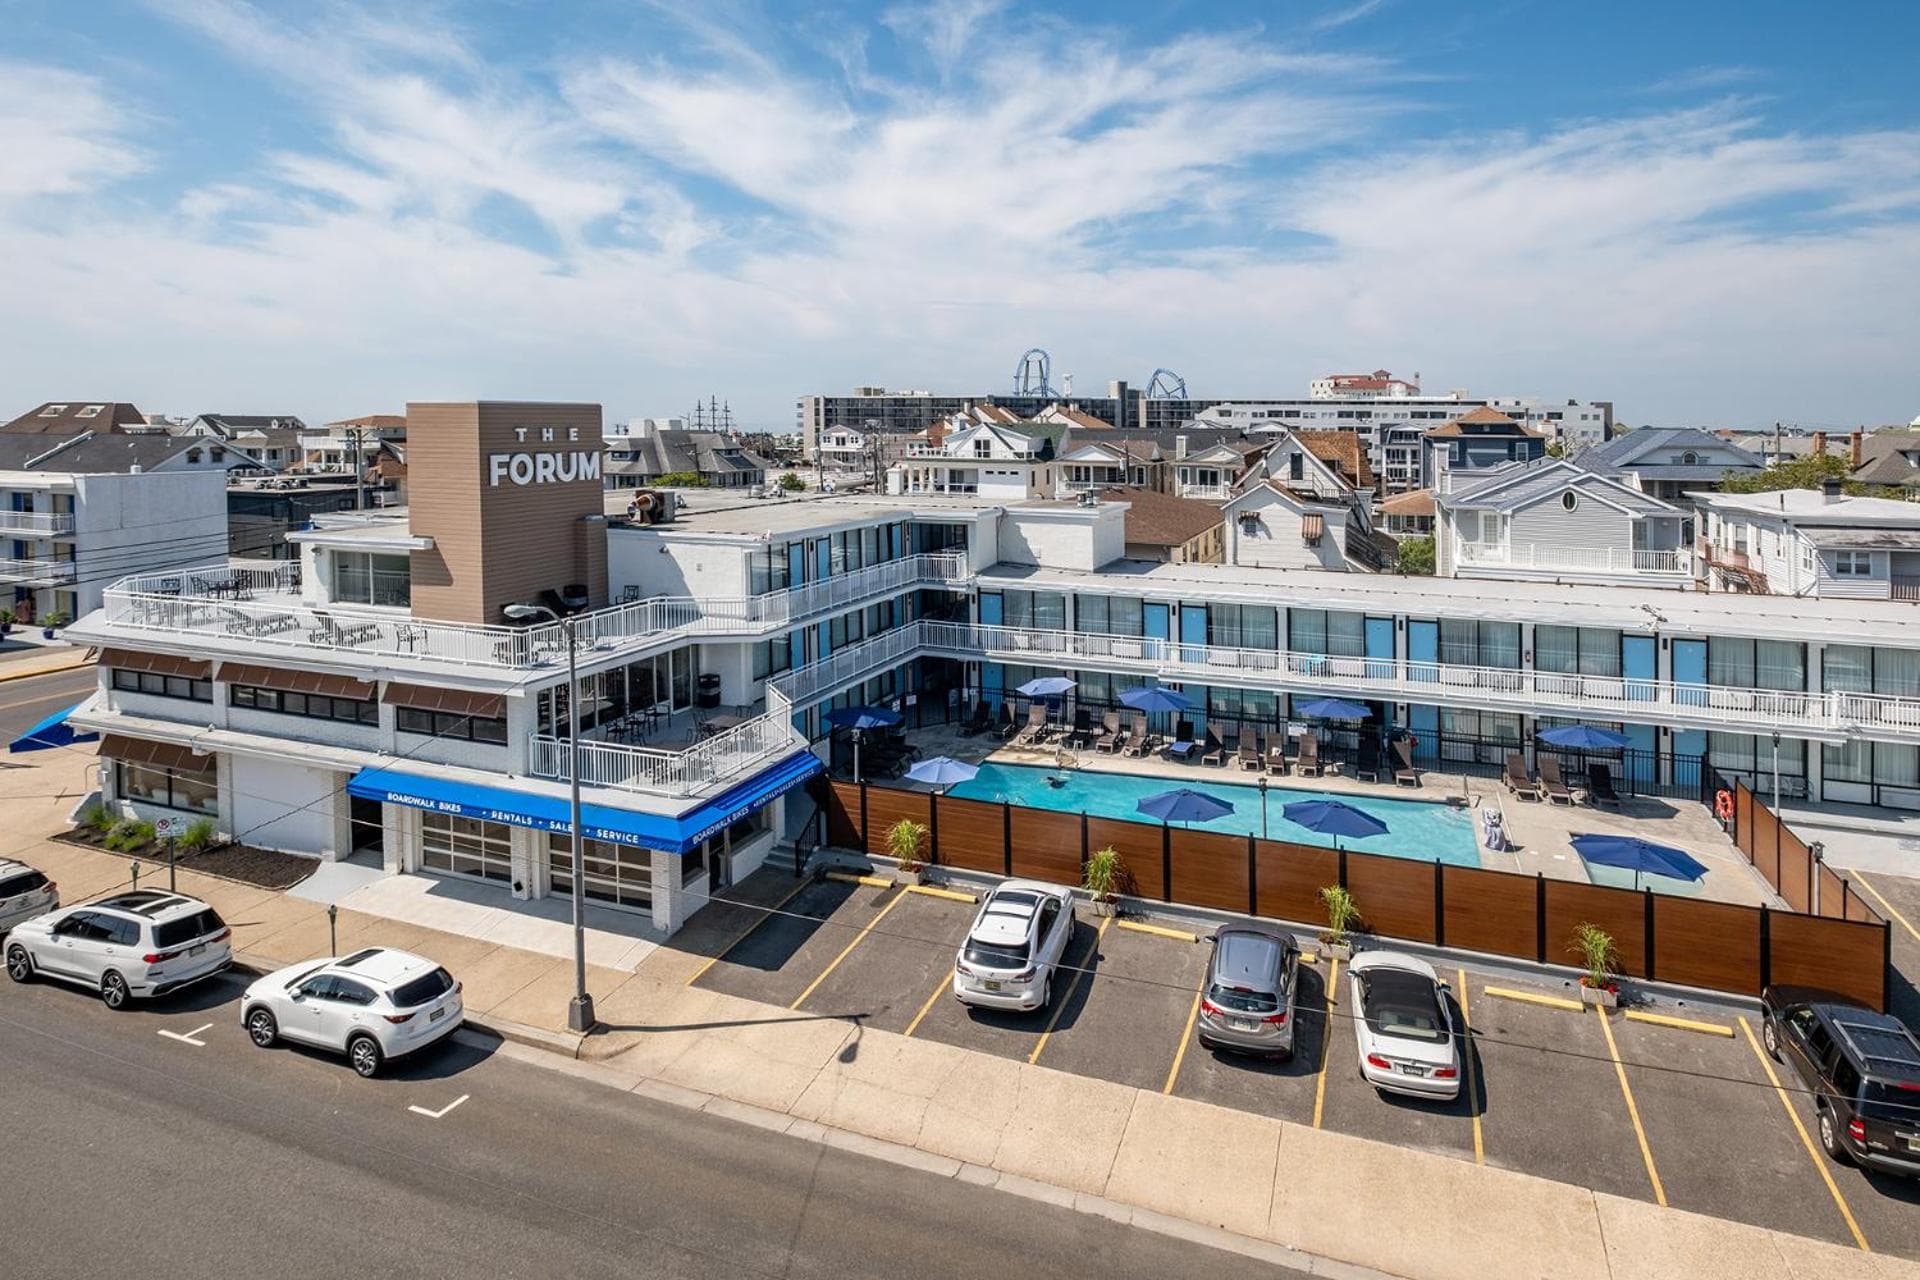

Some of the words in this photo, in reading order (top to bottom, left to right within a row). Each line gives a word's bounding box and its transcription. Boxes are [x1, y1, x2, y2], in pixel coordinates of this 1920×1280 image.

[514, 427, 579, 442] THE
[489, 451, 600, 487] FORUM
[387, 792, 436, 809] BOARDWALK
[438, 801, 462, 813] BIKES
[491, 810, 532, 825] RENTALS
[549, 820, 574, 833] SALE
[596, 828, 639, 844] SERVICE
